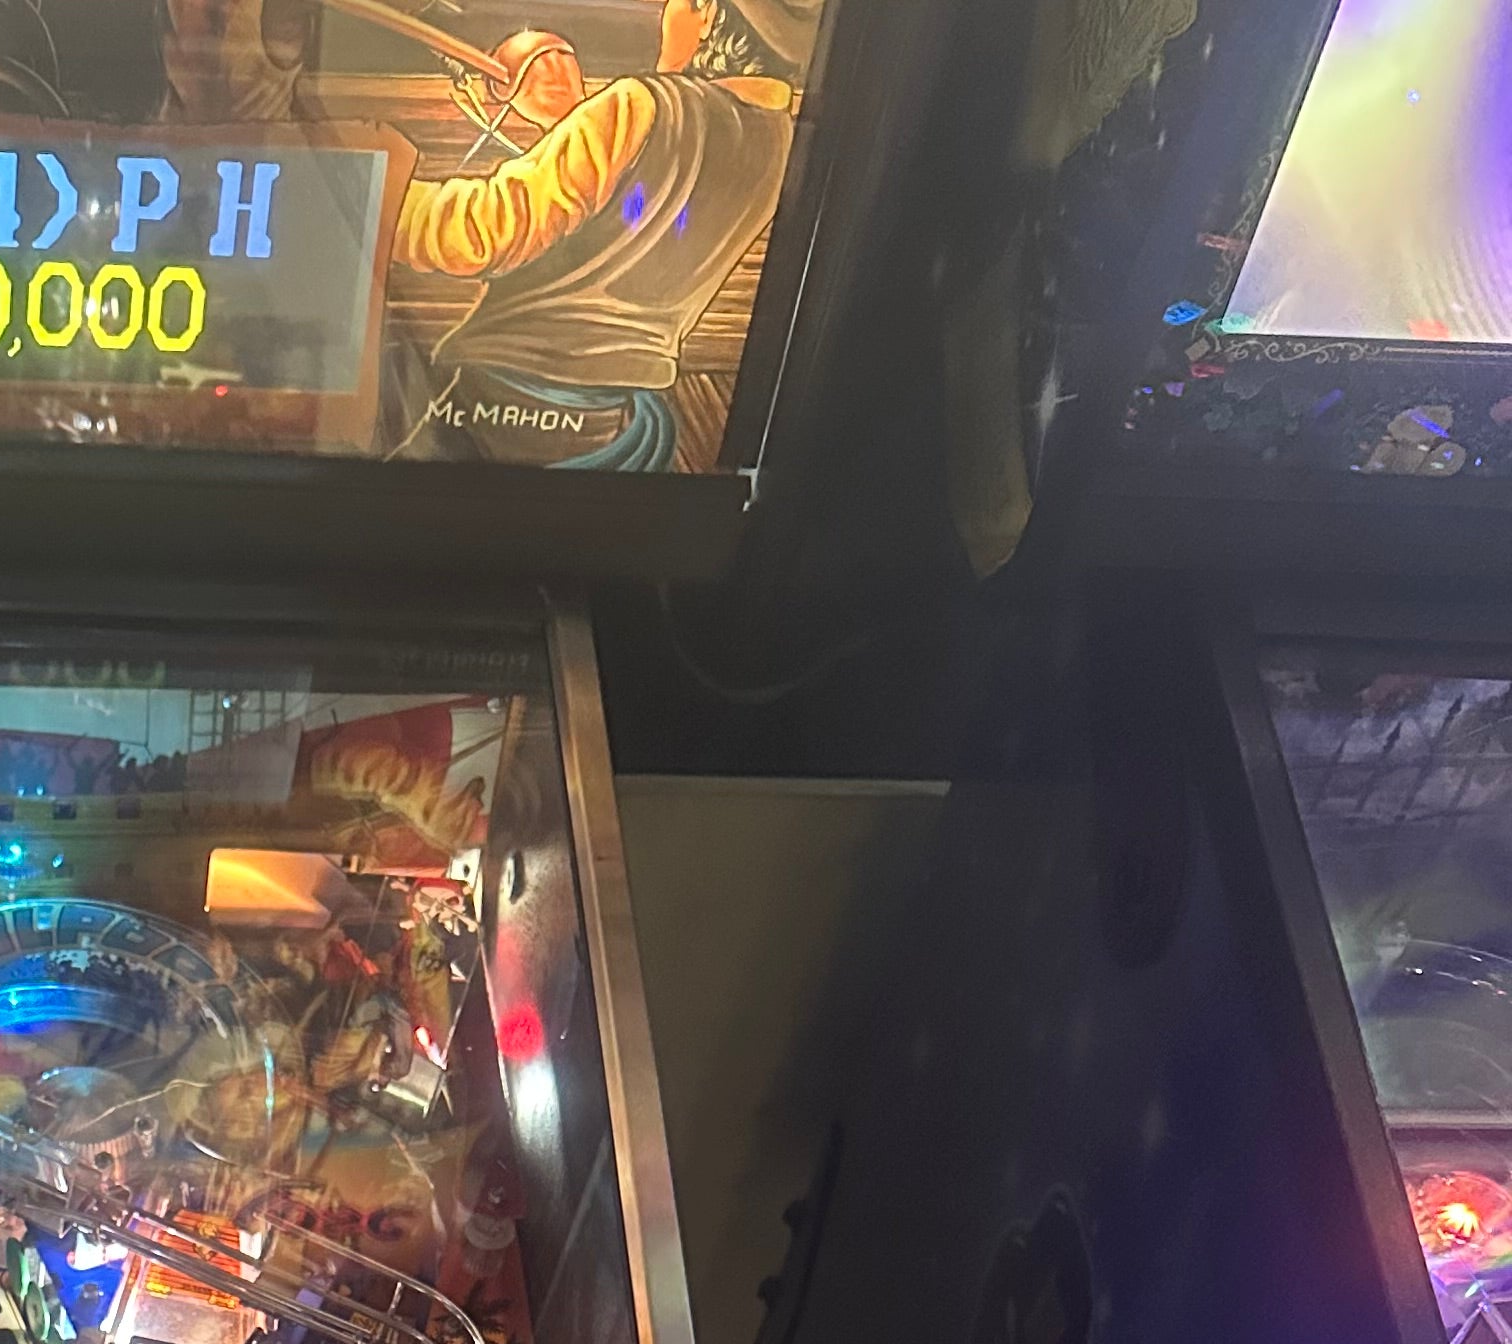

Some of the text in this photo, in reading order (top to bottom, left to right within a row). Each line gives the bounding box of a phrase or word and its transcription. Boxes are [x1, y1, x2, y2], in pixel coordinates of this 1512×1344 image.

[109, 156, 180, 252] P
[208, 160, 281, 258] H
[472, 402, 584, 432] MAHON
